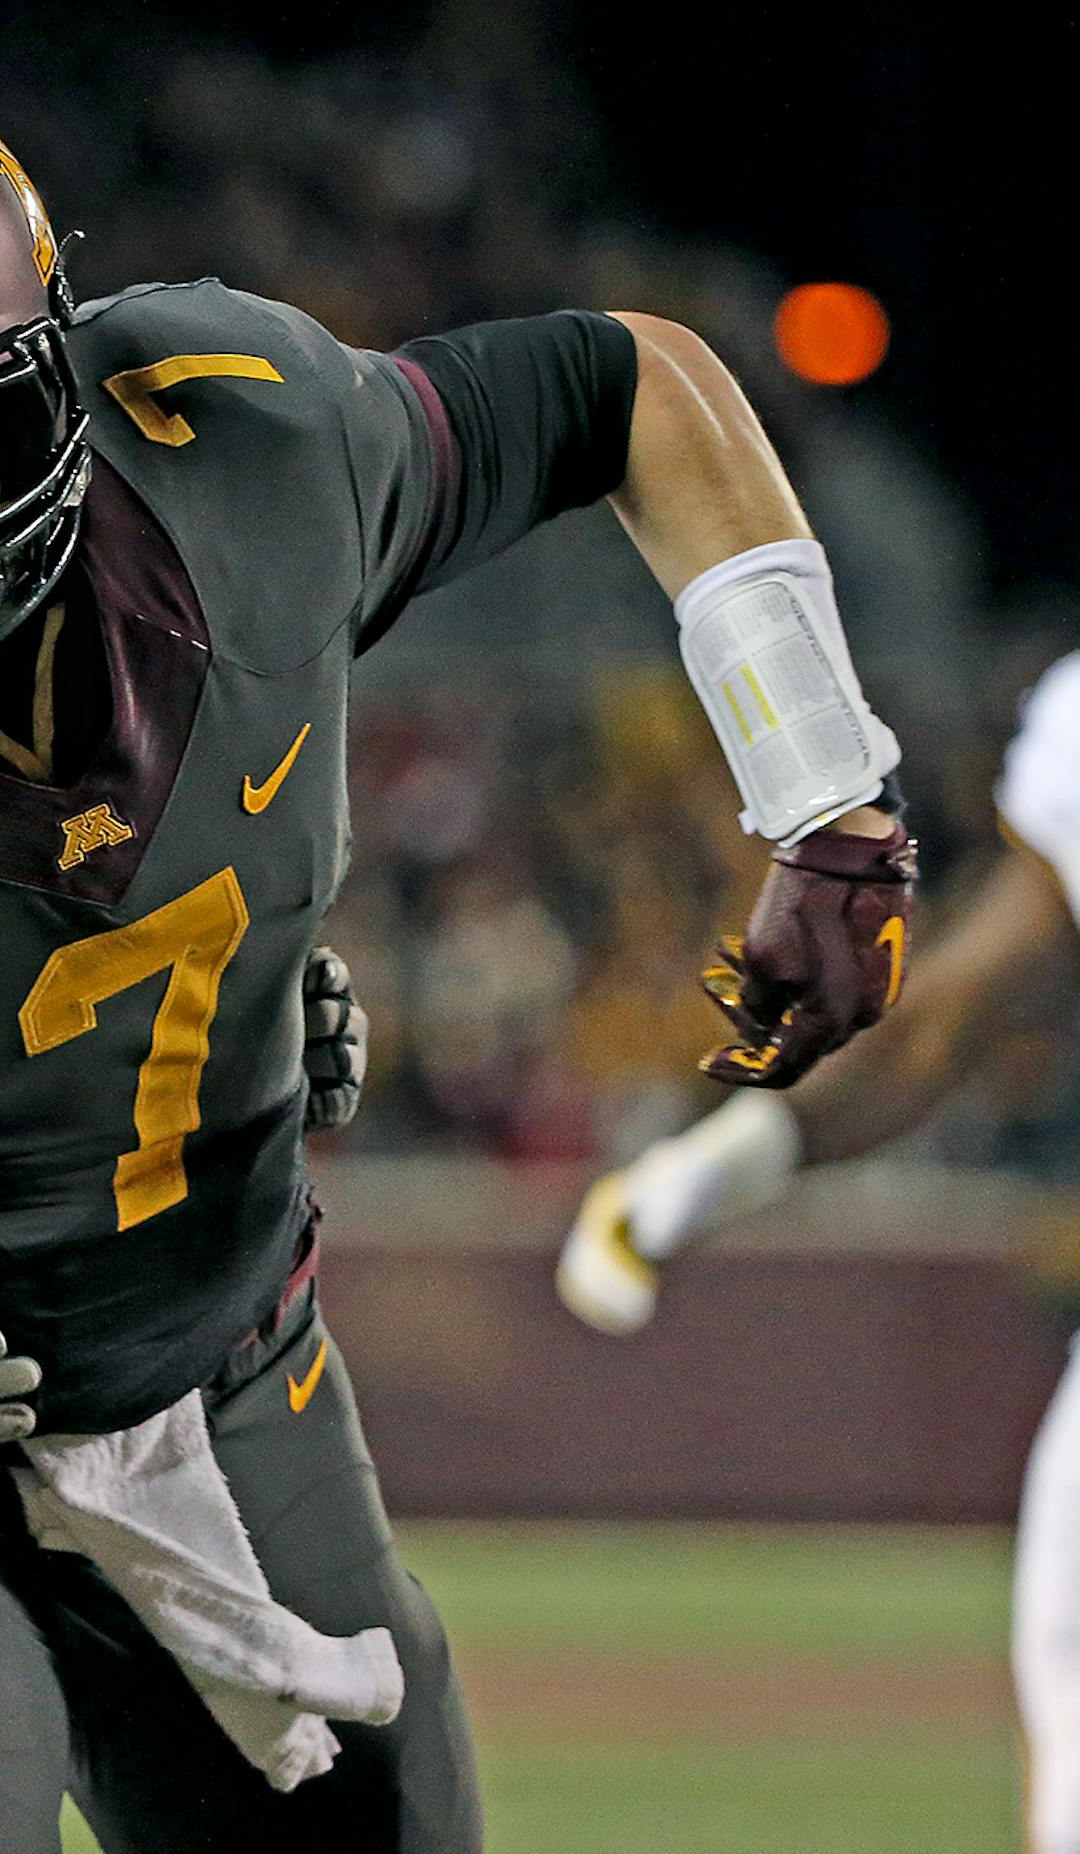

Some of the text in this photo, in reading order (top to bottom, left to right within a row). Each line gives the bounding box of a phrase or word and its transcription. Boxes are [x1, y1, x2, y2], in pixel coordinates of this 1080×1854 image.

[102, 353, 286, 448] 7
[57, 802, 137, 872] M
[18, 865, 251, 1233] 7
